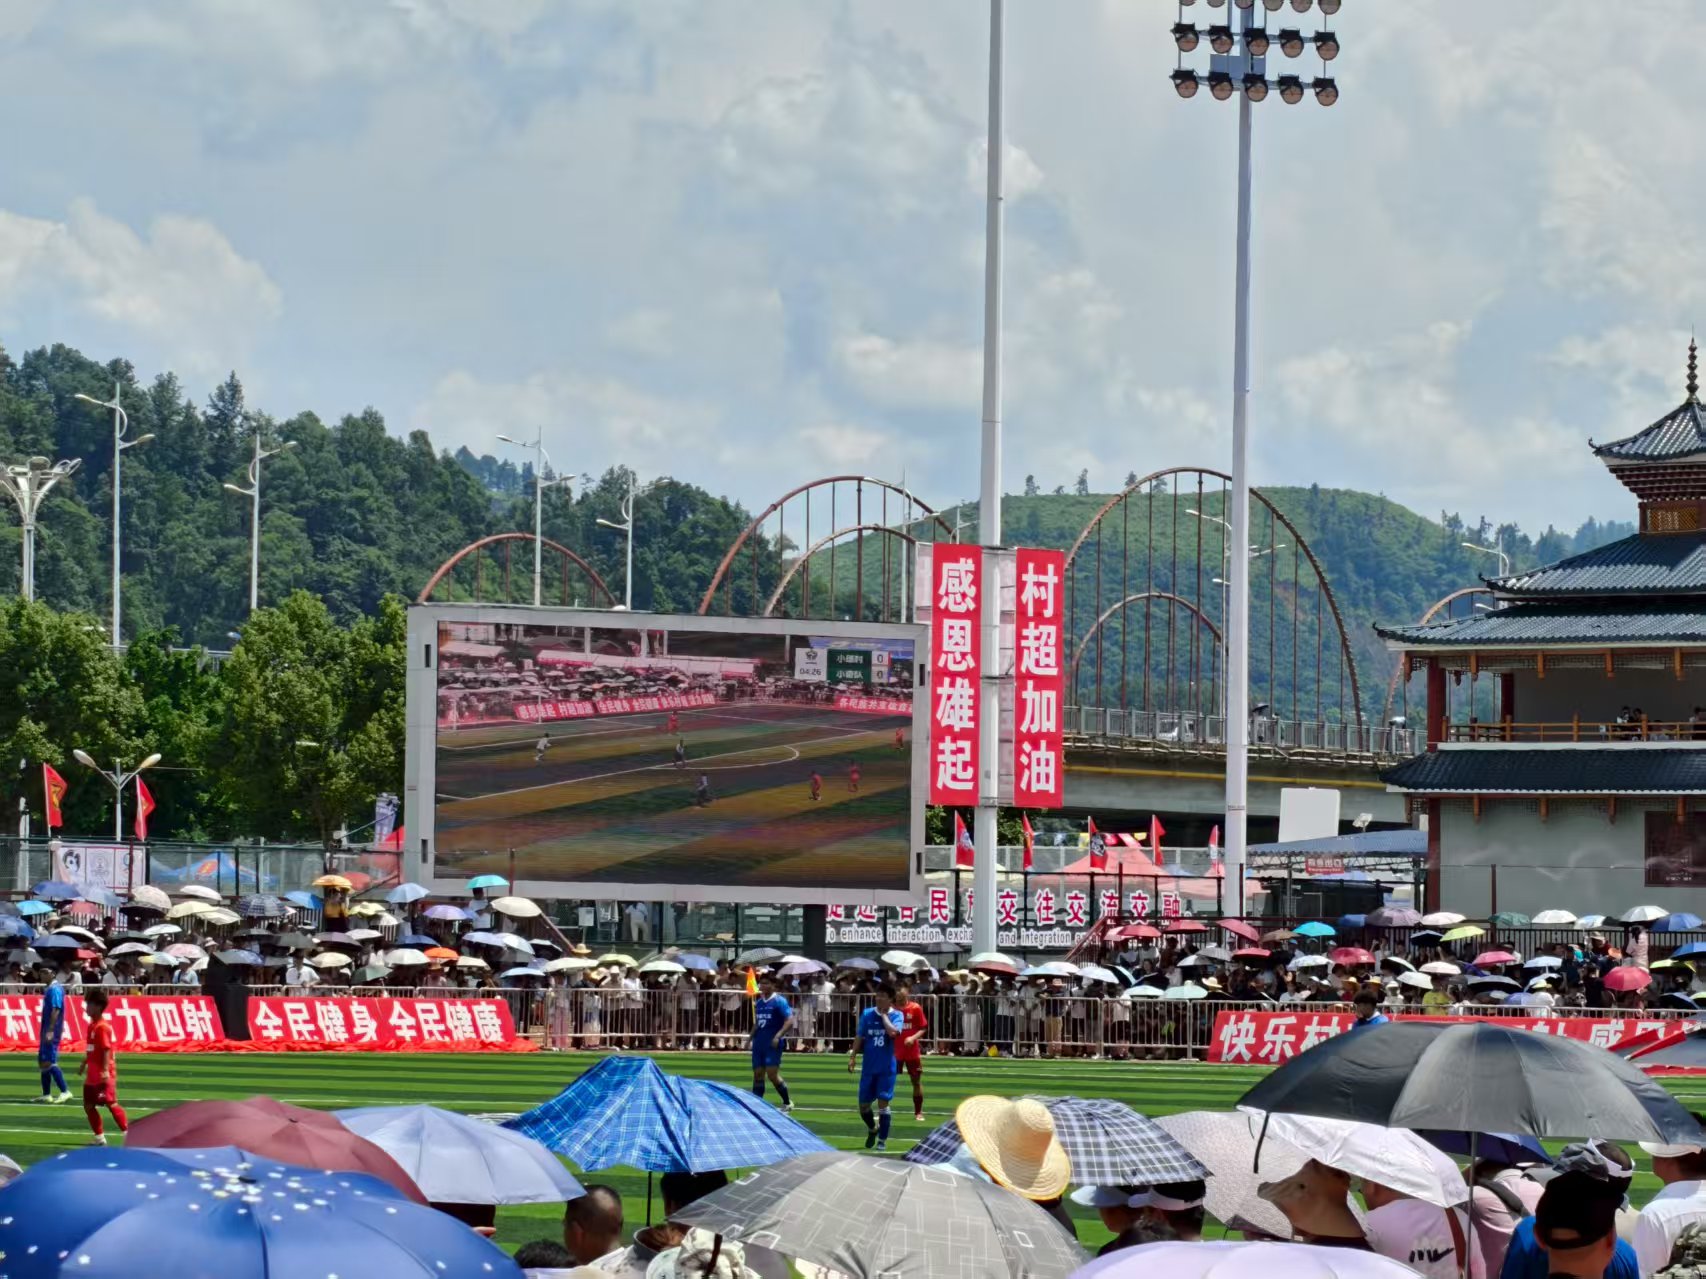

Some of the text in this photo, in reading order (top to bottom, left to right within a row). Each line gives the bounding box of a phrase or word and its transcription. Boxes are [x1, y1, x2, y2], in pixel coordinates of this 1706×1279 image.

[876, 653, 883, 663] 0
[876, 670, 883, 680] 0
[936, 557, 976, 790] 感恩雄起
[1020, 562, 1058, 794] 村超加油
[841, 923, 883, 943] enhance
[999, 929, 1017, 946] and
[1021, 928, 1072, 947] integration
[255, 1000, 504, 1042] 全民健身 全民健康
[873, 1036, 885, 1047] 16
